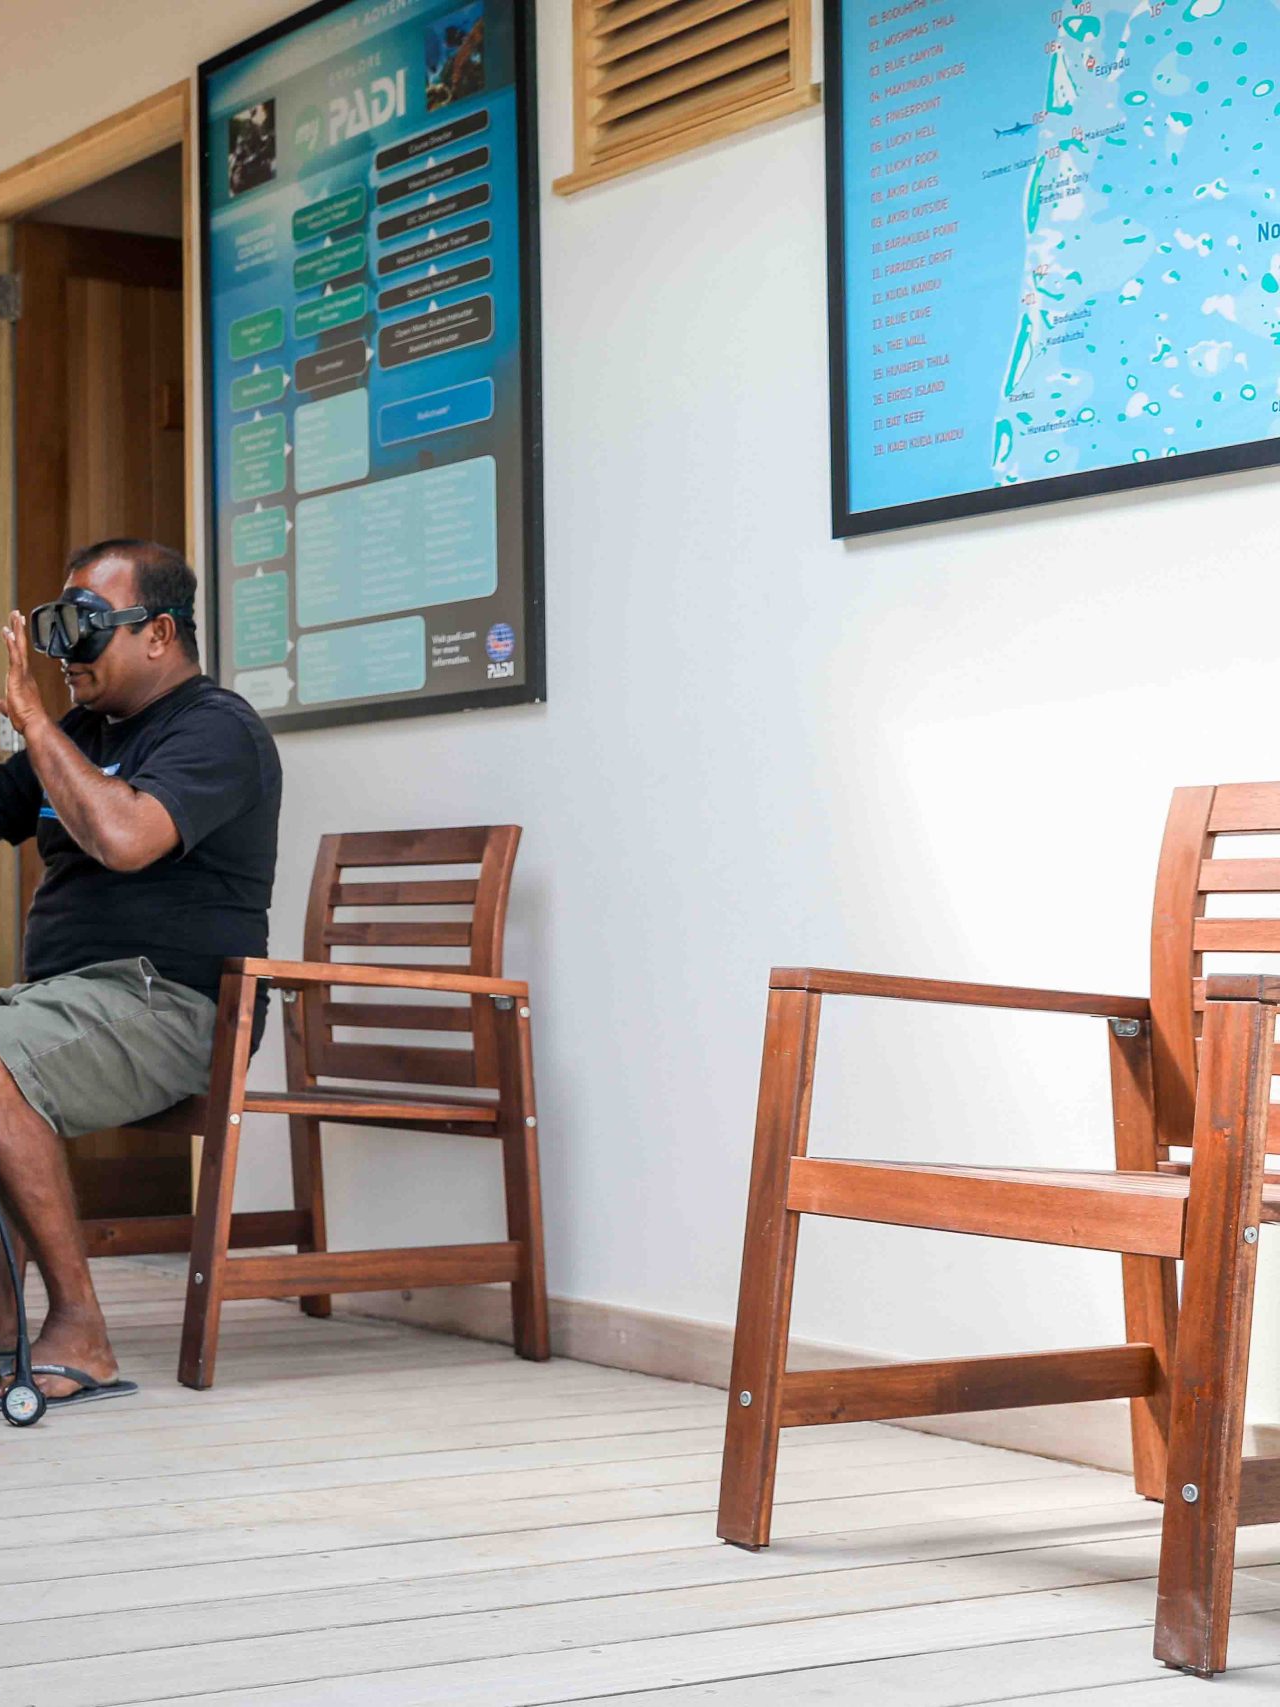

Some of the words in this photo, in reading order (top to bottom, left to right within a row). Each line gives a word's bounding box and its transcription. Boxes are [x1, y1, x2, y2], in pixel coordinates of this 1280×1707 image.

[1150, 4, 1162, 18] 16
[885, 56, 906, 72] BLUE
[936, 62, 966, 80] INSIDE
[329, 66, 408, 146] PADI
[915, 125, 936, 138] HELL
[933, 221, 959, 238] POINT
[1272, 401, 1280, 413] C
[487, 661, 515, 679] PADI
